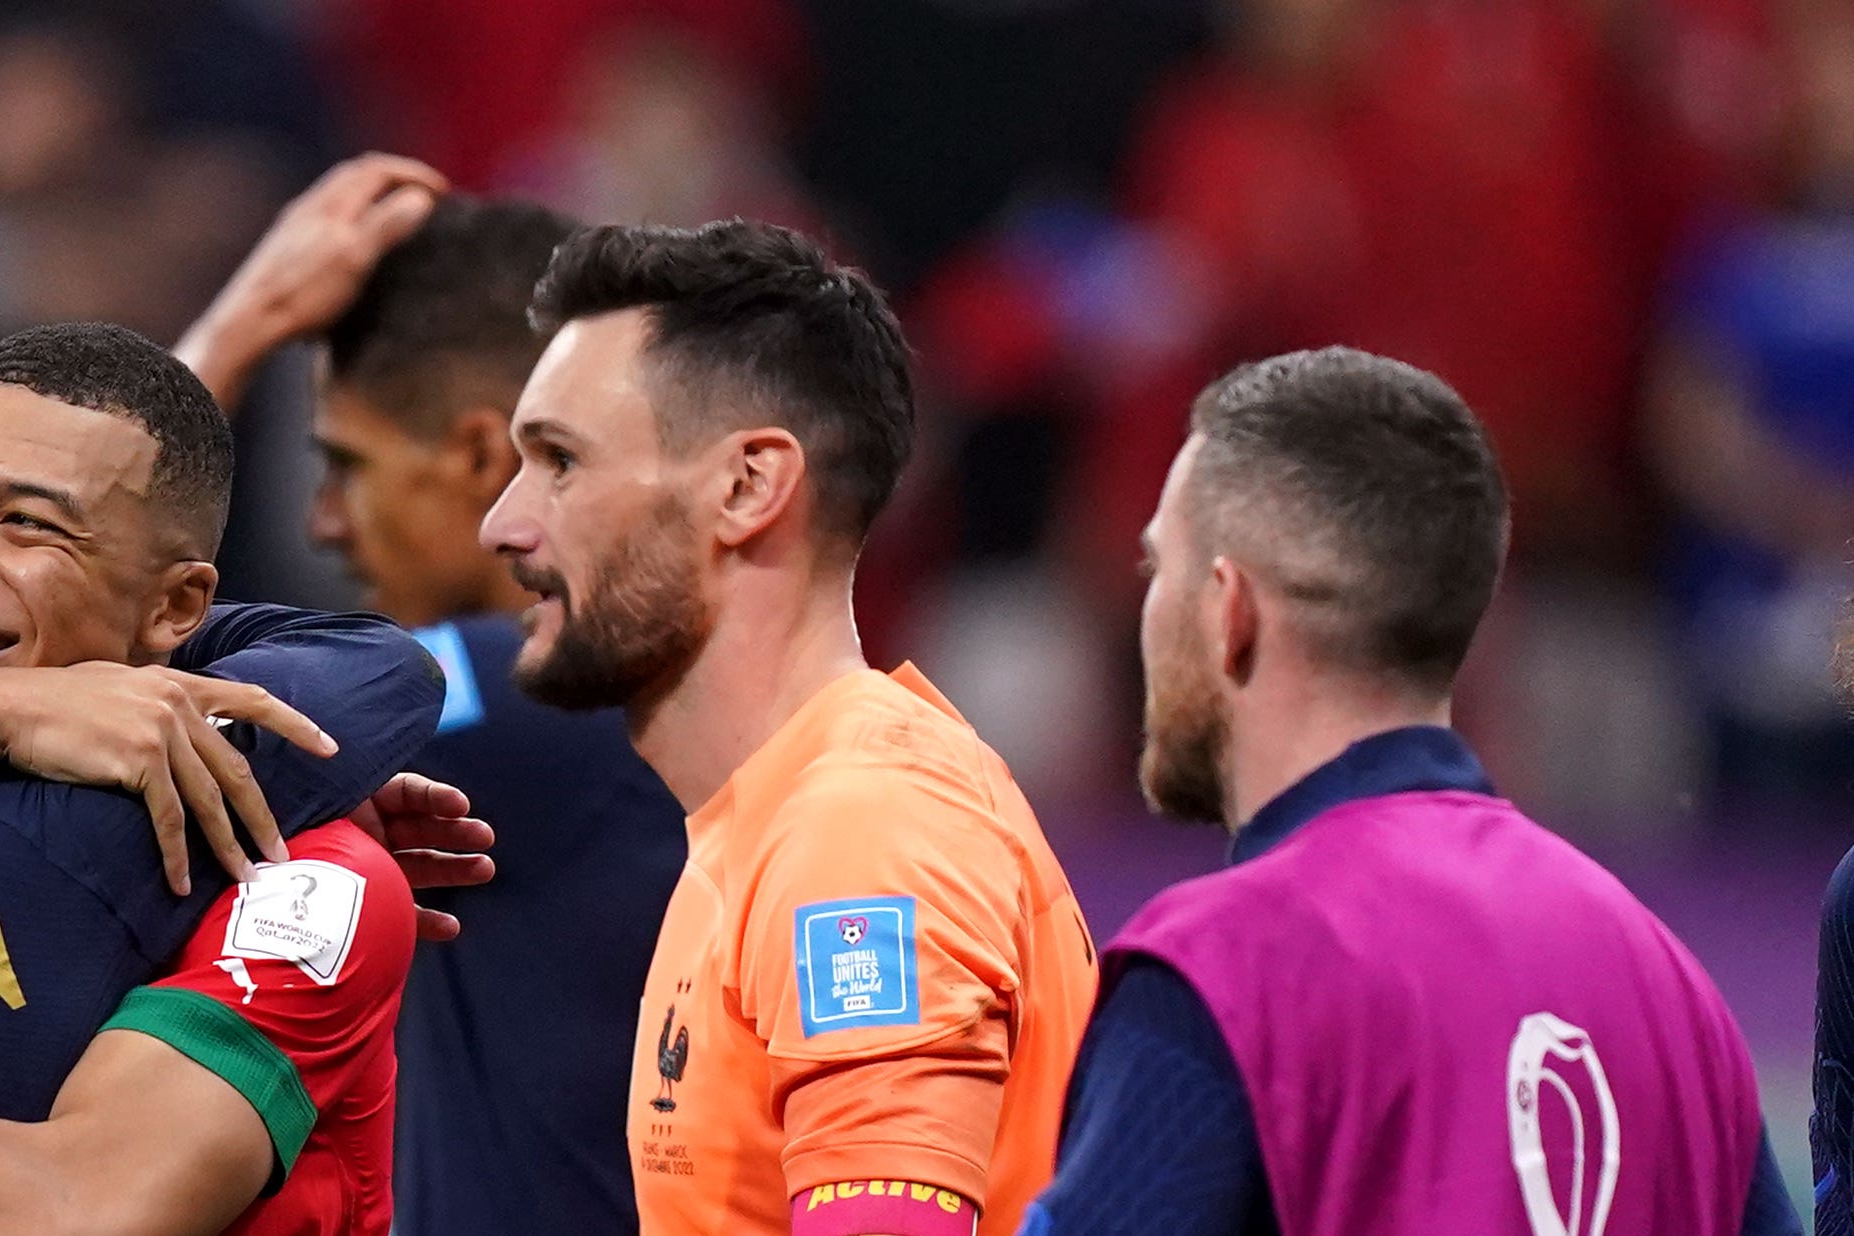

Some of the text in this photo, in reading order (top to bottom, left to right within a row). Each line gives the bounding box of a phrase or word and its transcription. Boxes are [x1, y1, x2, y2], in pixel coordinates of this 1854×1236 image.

[253, 917, 275, 928] FIFA
[277, 922, 313, 939] WORLD
[832, 949, 878, 966] FOOTBALL
[832, 961, 880, 984] UNITES
